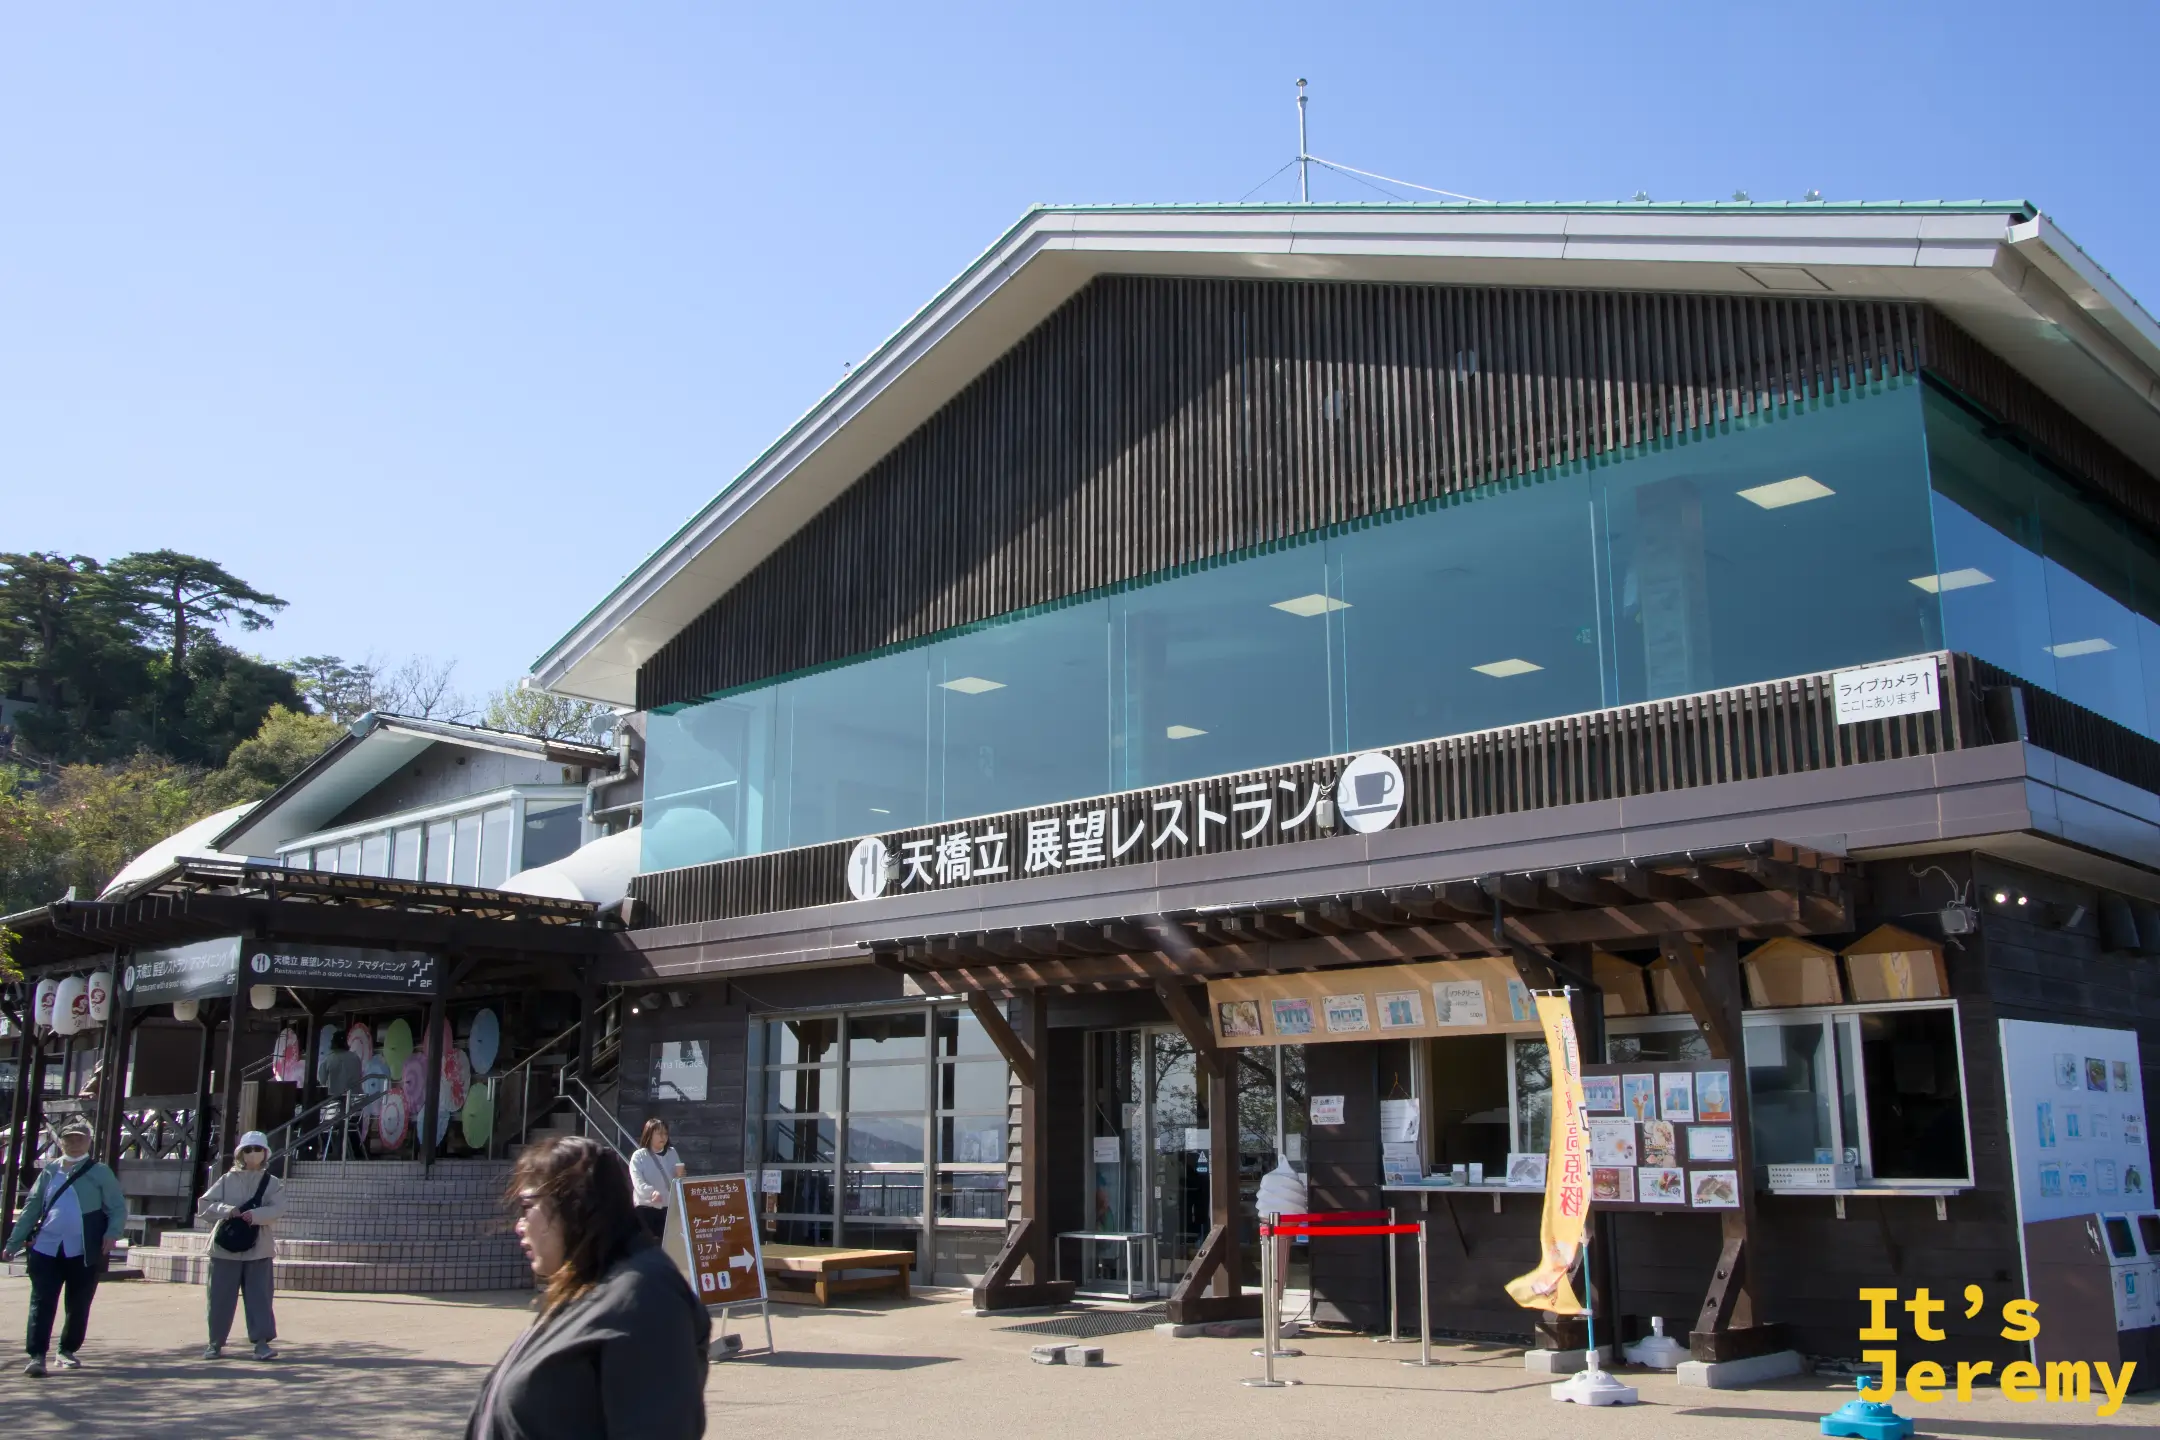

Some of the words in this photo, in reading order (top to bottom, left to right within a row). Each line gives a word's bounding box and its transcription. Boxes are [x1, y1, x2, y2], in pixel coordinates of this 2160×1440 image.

[1840, 673, 1918, 697] ライブカメラ
[1841, 690, 1920, 713] ここにあります
[901, 825, 1009, 889] 天橋立
[1024, 780, 1319, 872] 展望レストラン
[273, 954, 299, 966] 天橋立
[300, 956, 353, 969] 展望レストラン
[357, 960, 407, 973] アマダイニング
[226, 973, 237, 985] 2F
[274, 967, 307, 976] Restaurant
[308, 969, 322, 977] with
[419, 980, 433, 988] 2F
[655, 1060, 673, 1070] Ama
[675, 1059, 703, 1069] Terrace
[690, 1183, 740, 1196] おかえりはこちら
[693, 1213, 745, 1228] ケーブルカー
[697, 1241, 722, 1255] リフト
